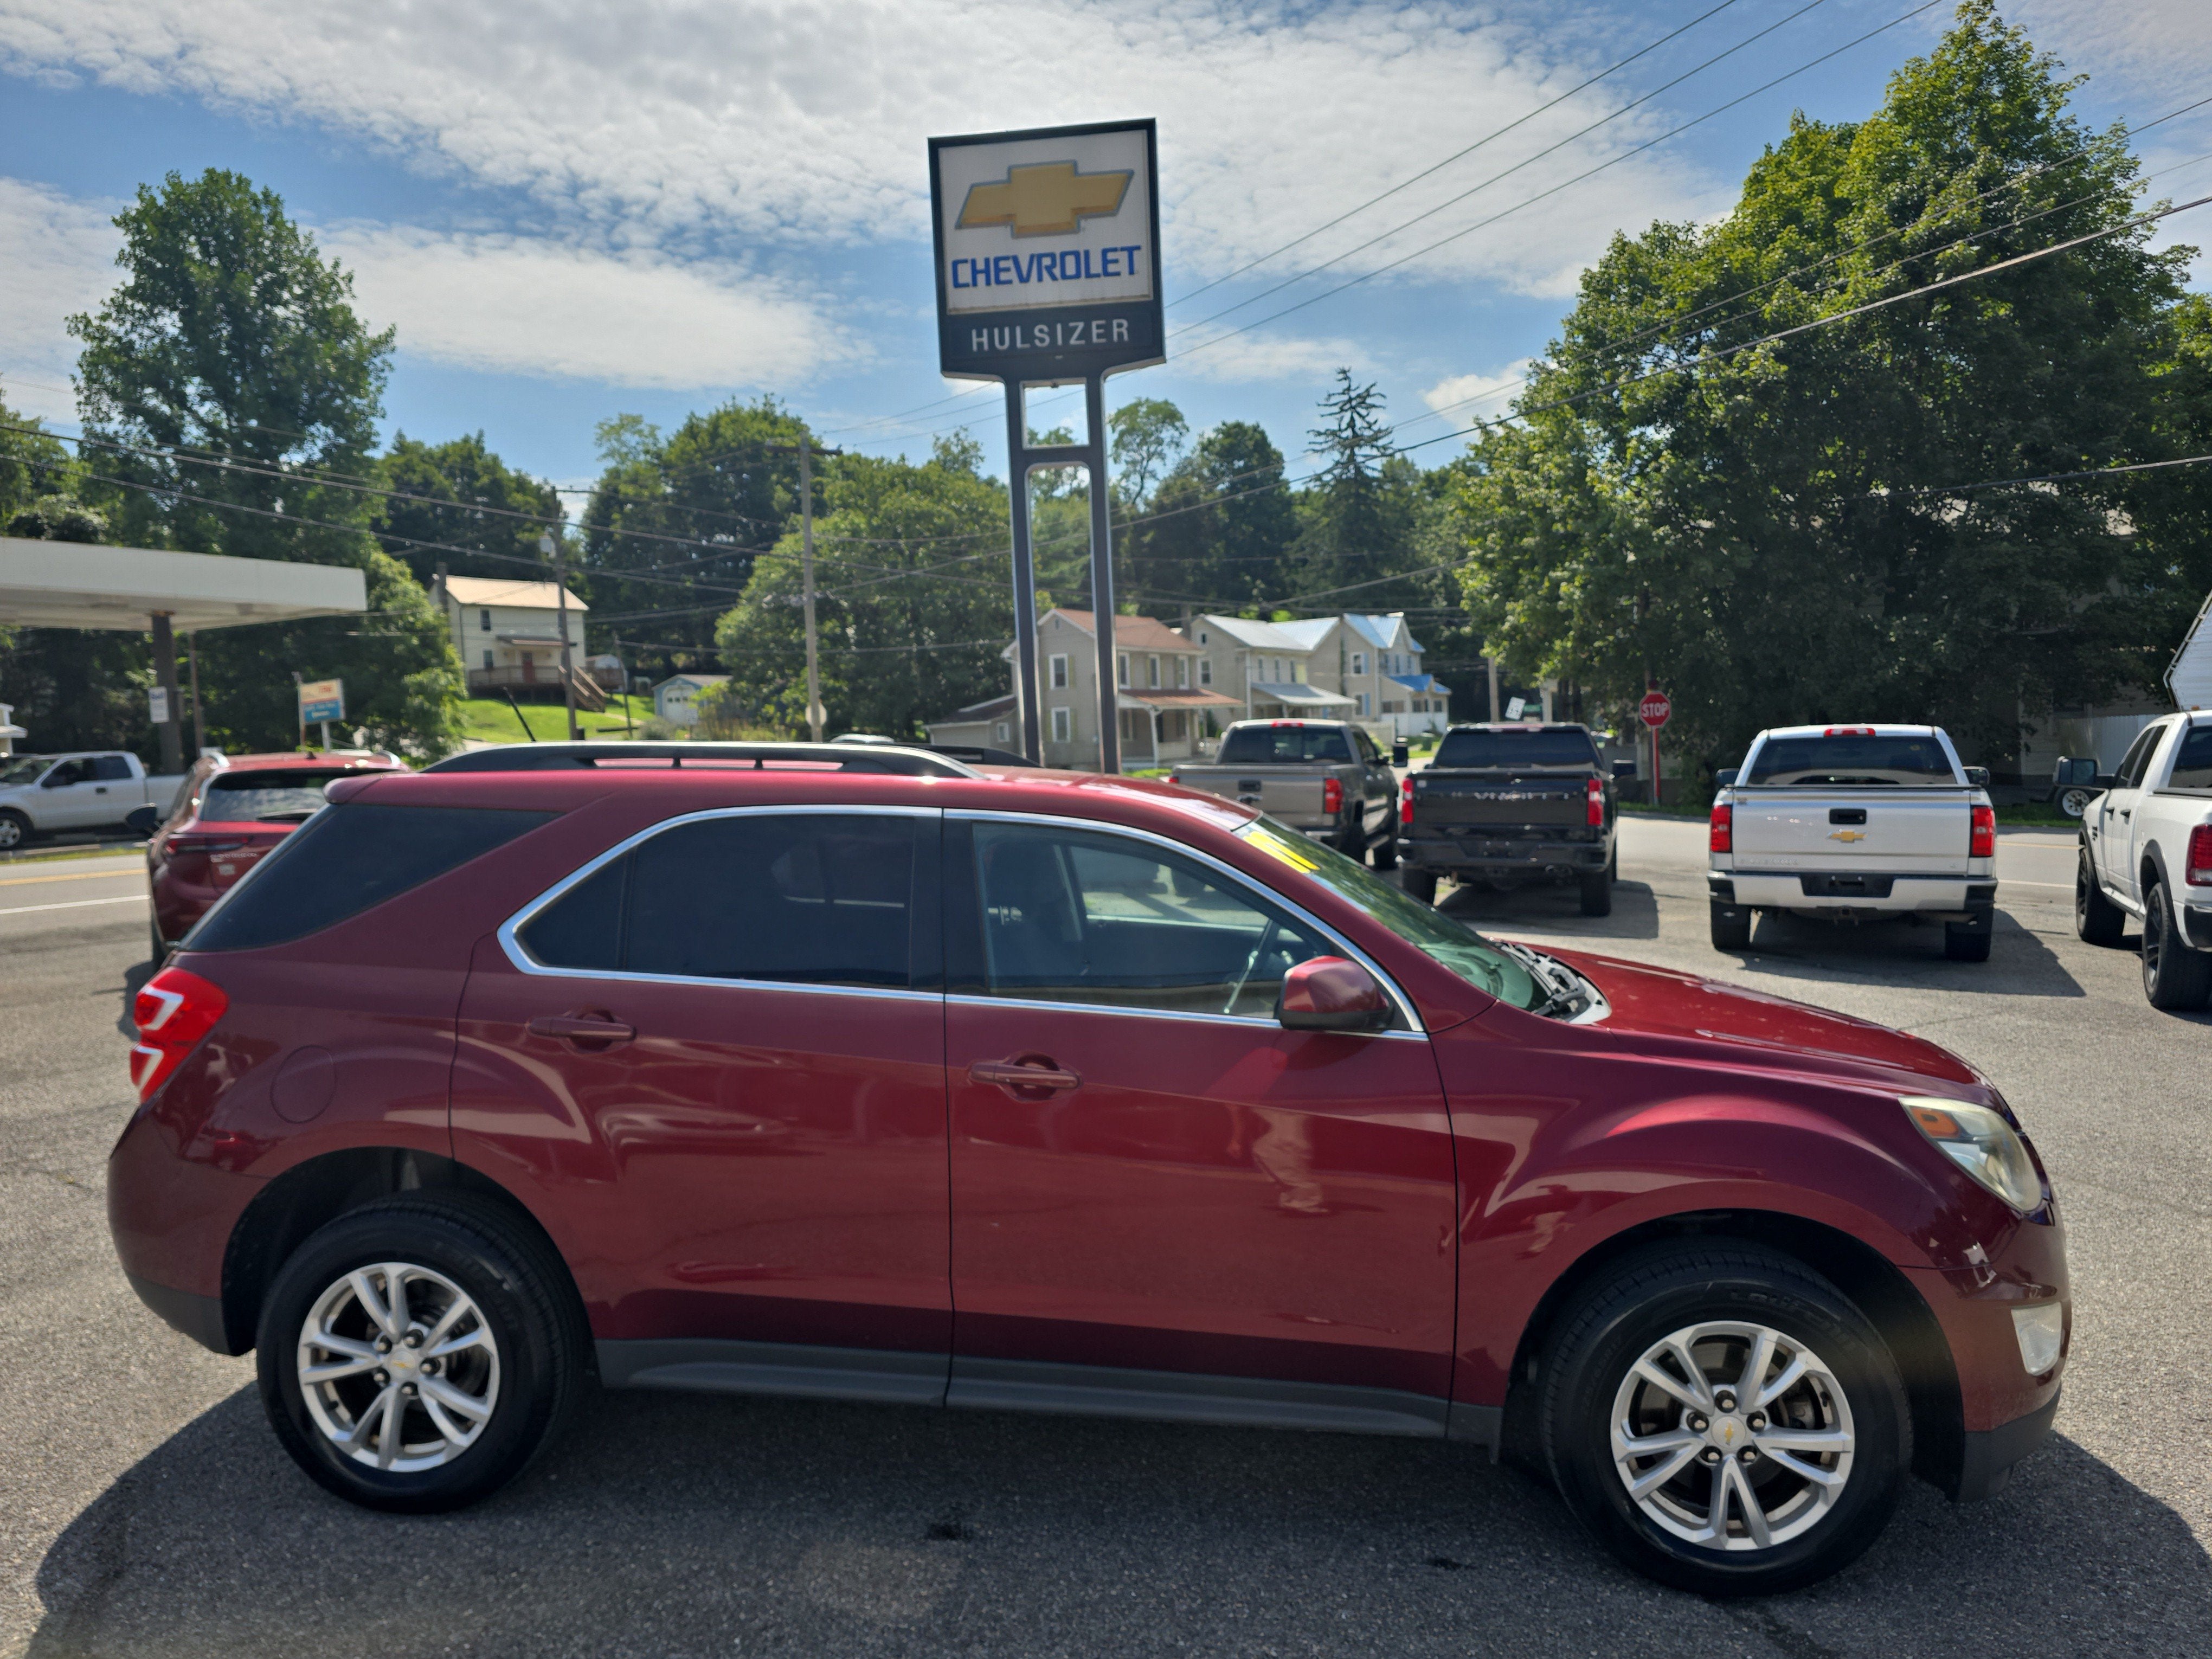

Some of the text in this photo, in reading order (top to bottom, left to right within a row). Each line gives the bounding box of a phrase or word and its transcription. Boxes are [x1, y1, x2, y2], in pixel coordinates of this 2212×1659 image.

[951, 245, 1141, 288] CHEVROLET
[971, 318, 1129, 352] HULSIZER
[1642, 702, 1668, 717] STOP
